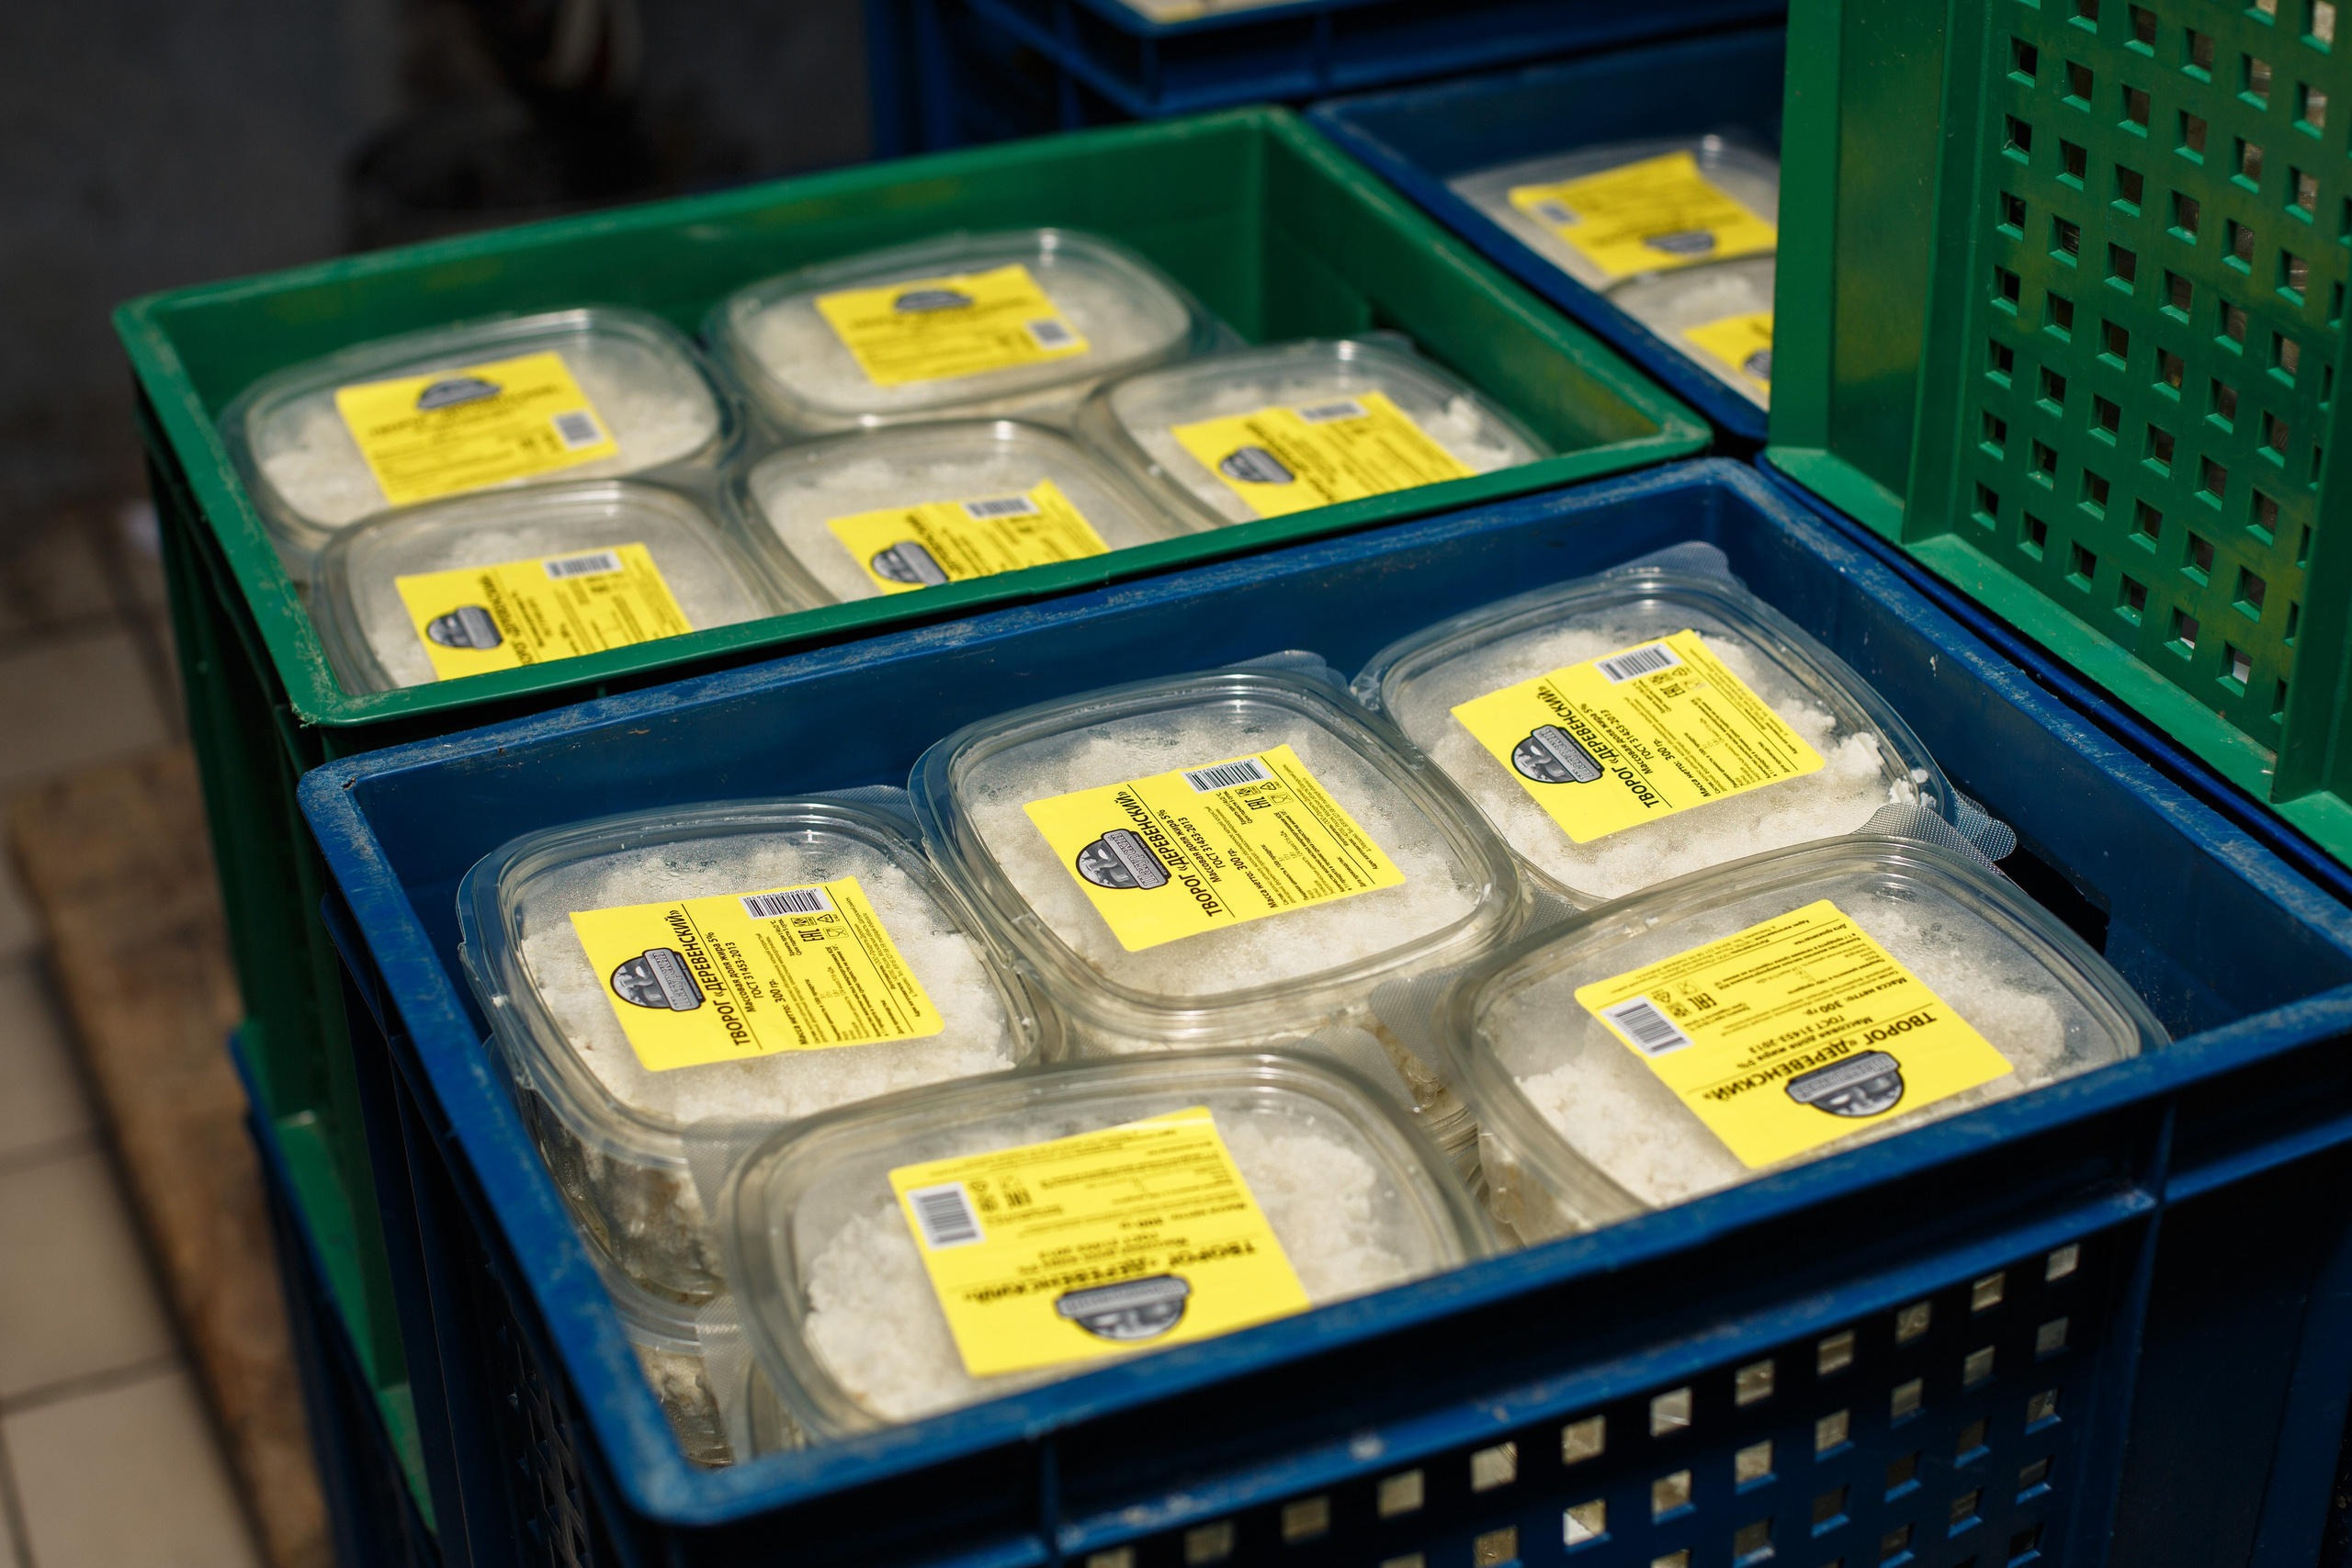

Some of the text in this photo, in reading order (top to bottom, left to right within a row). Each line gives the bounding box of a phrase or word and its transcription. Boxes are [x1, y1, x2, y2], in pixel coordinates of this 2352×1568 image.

[1536, 682, 1620, 764] «ДЕРЕВЕНСКИЙ»
[1657, 747, 1676, 761] 300
[1611, 766, 1660, 809] ТВОРОГ
[1114, 791, 1190, 875] «ДЕРЕВЕНСКИЙ»
[1156, 808, 1223, 884] Массовая доля жира 5%
[1177, 817, 1227, 869] ГОСТ 31453-2013
[1177, 874, 1223, 918] ТВОРОГ
[1227, 847, 1279, 908] Масса нетто: 300 гр.
[663, 908, 728, 1000] «ДЕРЕВЕНСКИЙ»
[705, 931, 718, 943] 5%
[712, 999, 751, 1046] ТВОРОГ
[768, 978, 809, 1045] Масса нетто: 300 гр.
[1818, 999, 1844, 1013] 300
